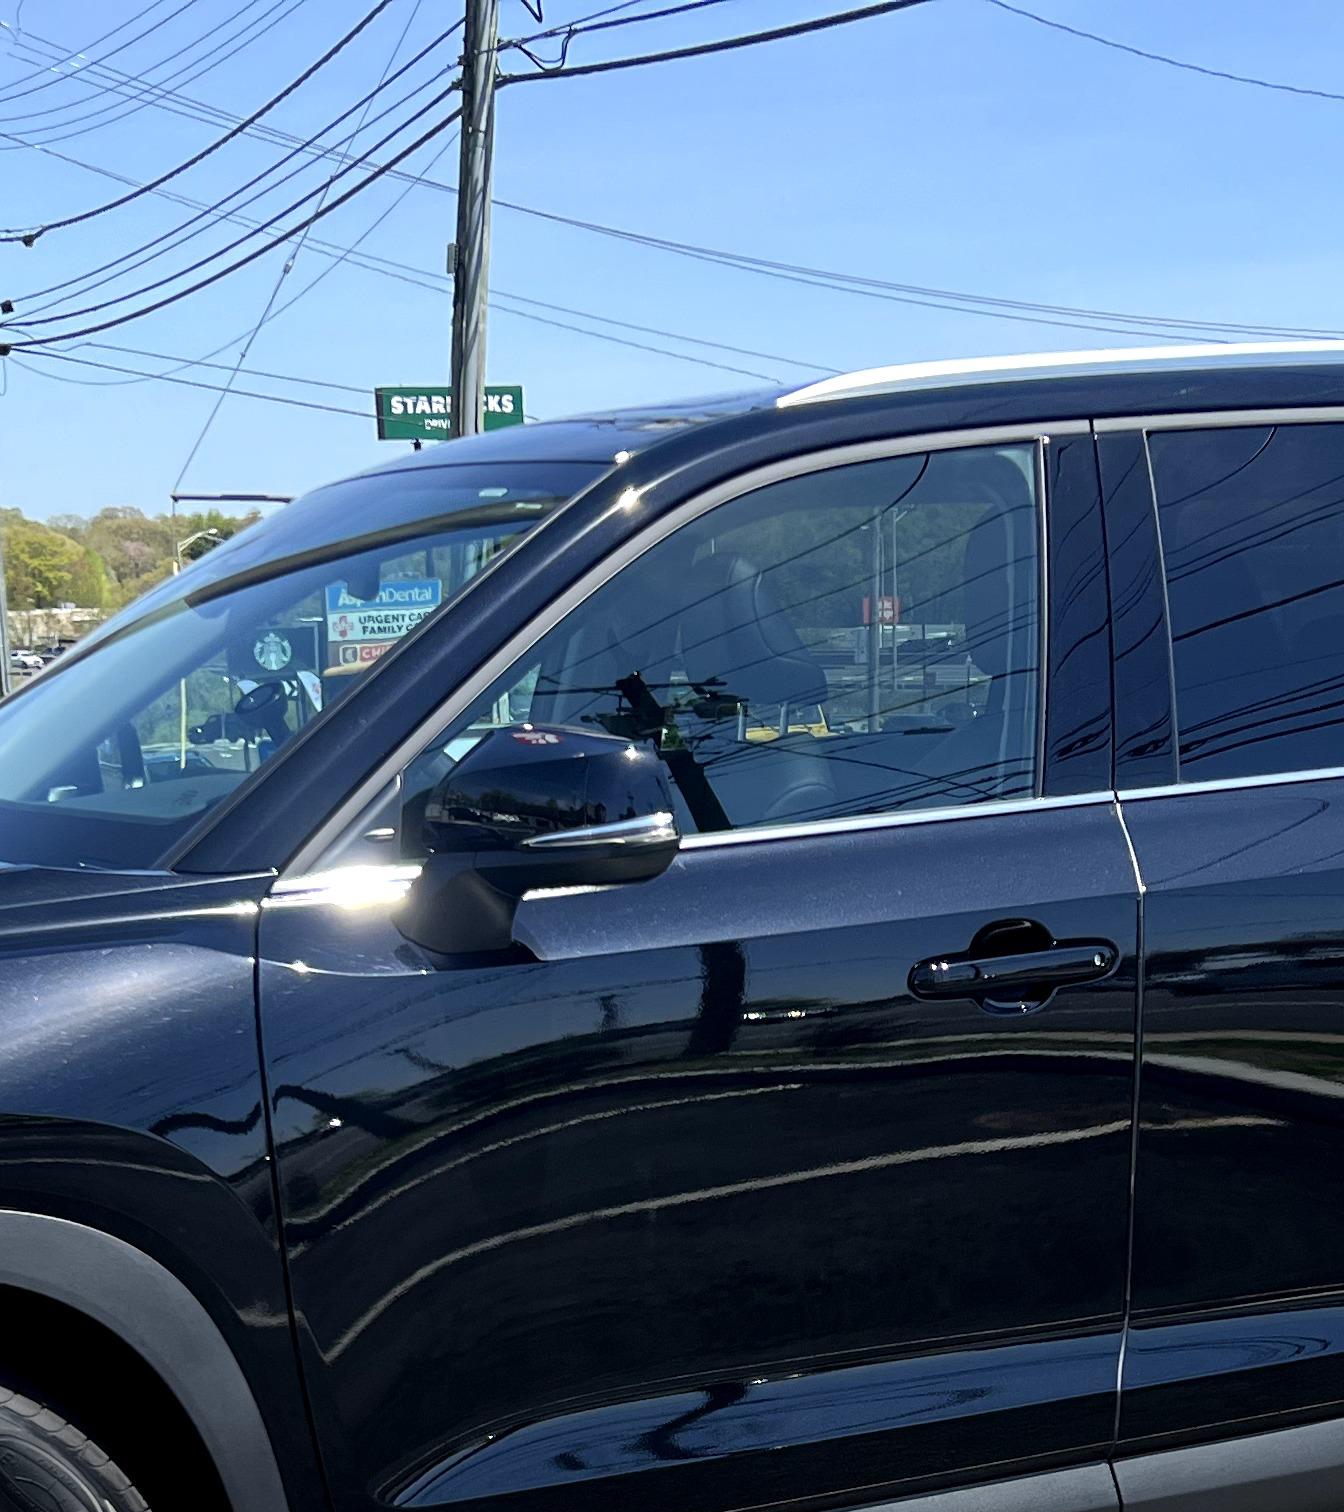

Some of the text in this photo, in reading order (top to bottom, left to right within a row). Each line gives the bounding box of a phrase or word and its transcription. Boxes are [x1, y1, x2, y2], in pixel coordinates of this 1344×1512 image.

[390, 394, 514, 415] STARKS
[424, 418, 451, 431] DRIV
[358, 614, 406, 625] URGENT
[362, 624, 404, 635] FAMILY
